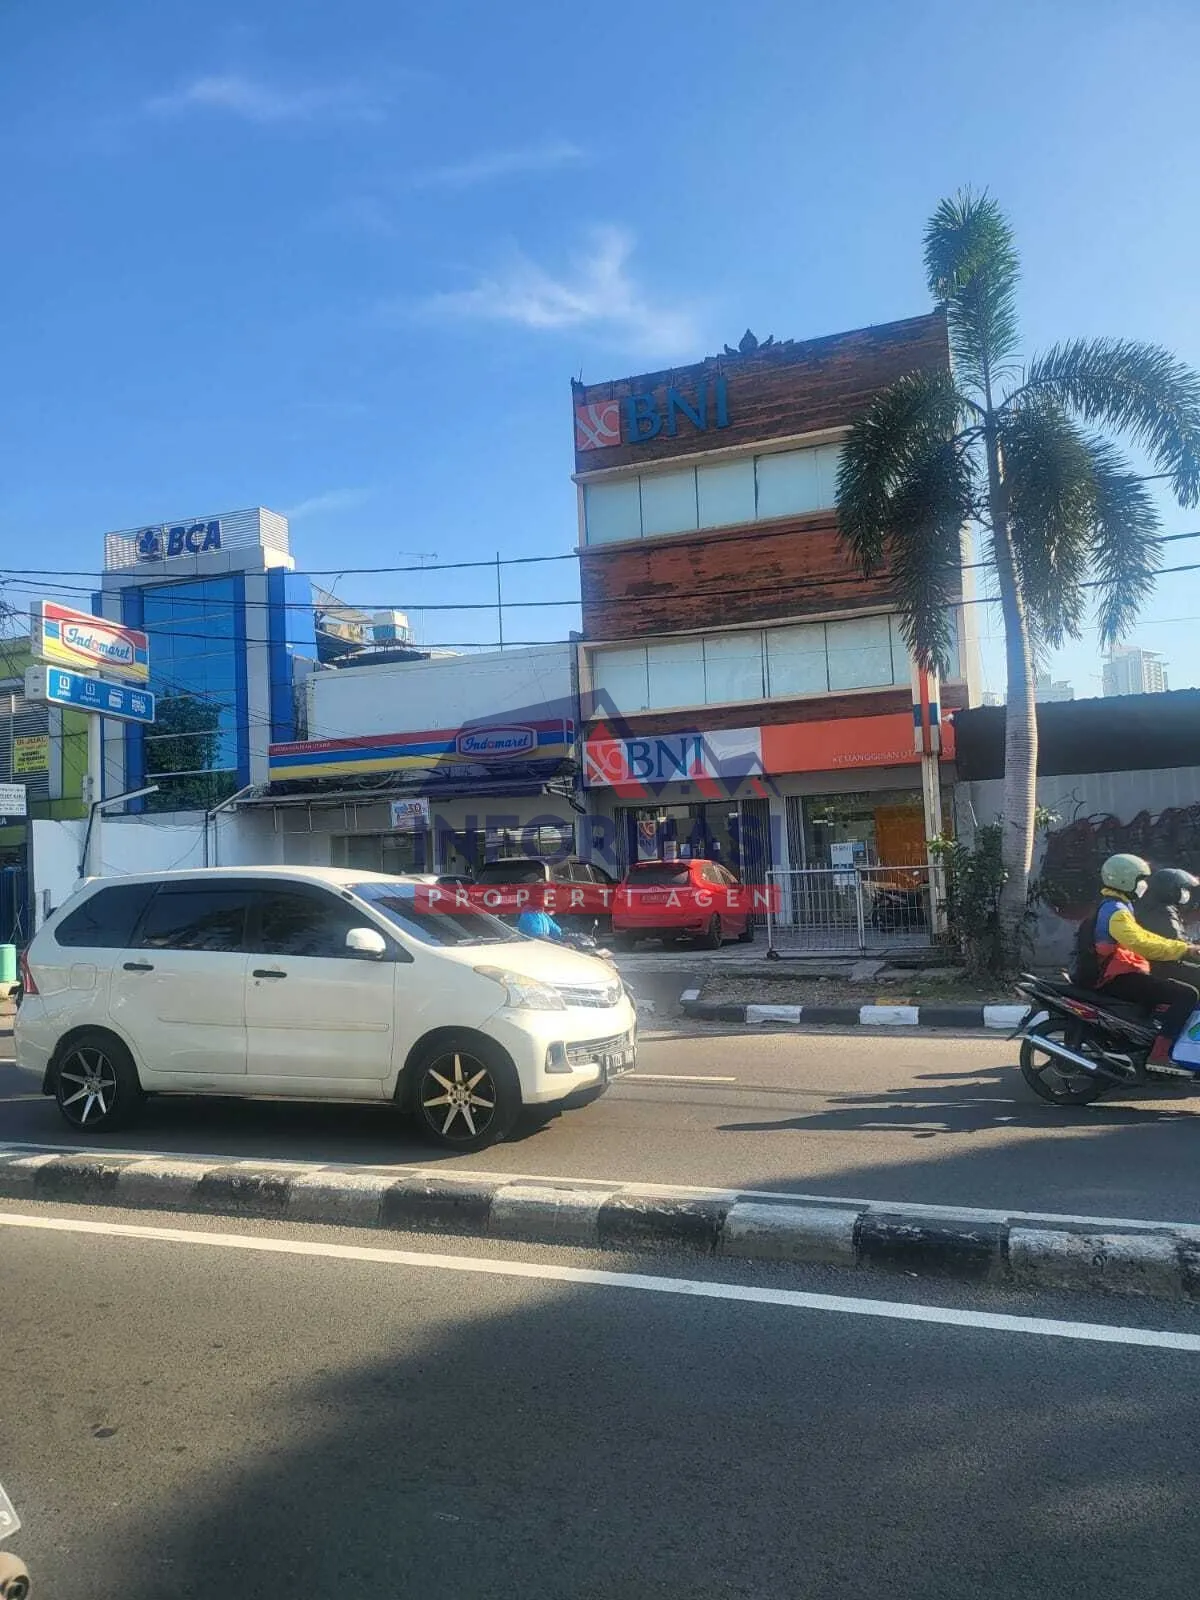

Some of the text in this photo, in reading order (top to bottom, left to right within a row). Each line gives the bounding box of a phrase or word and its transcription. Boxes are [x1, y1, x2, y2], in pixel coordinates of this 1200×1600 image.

[624, 374, 732, 444] BNI
[166, 520, 223, 556] BCA
[64, 627, 130, 659] Indomaret
[461, 734, 529, 751] Indomaret
[627, 736, 705, 780] BNI
